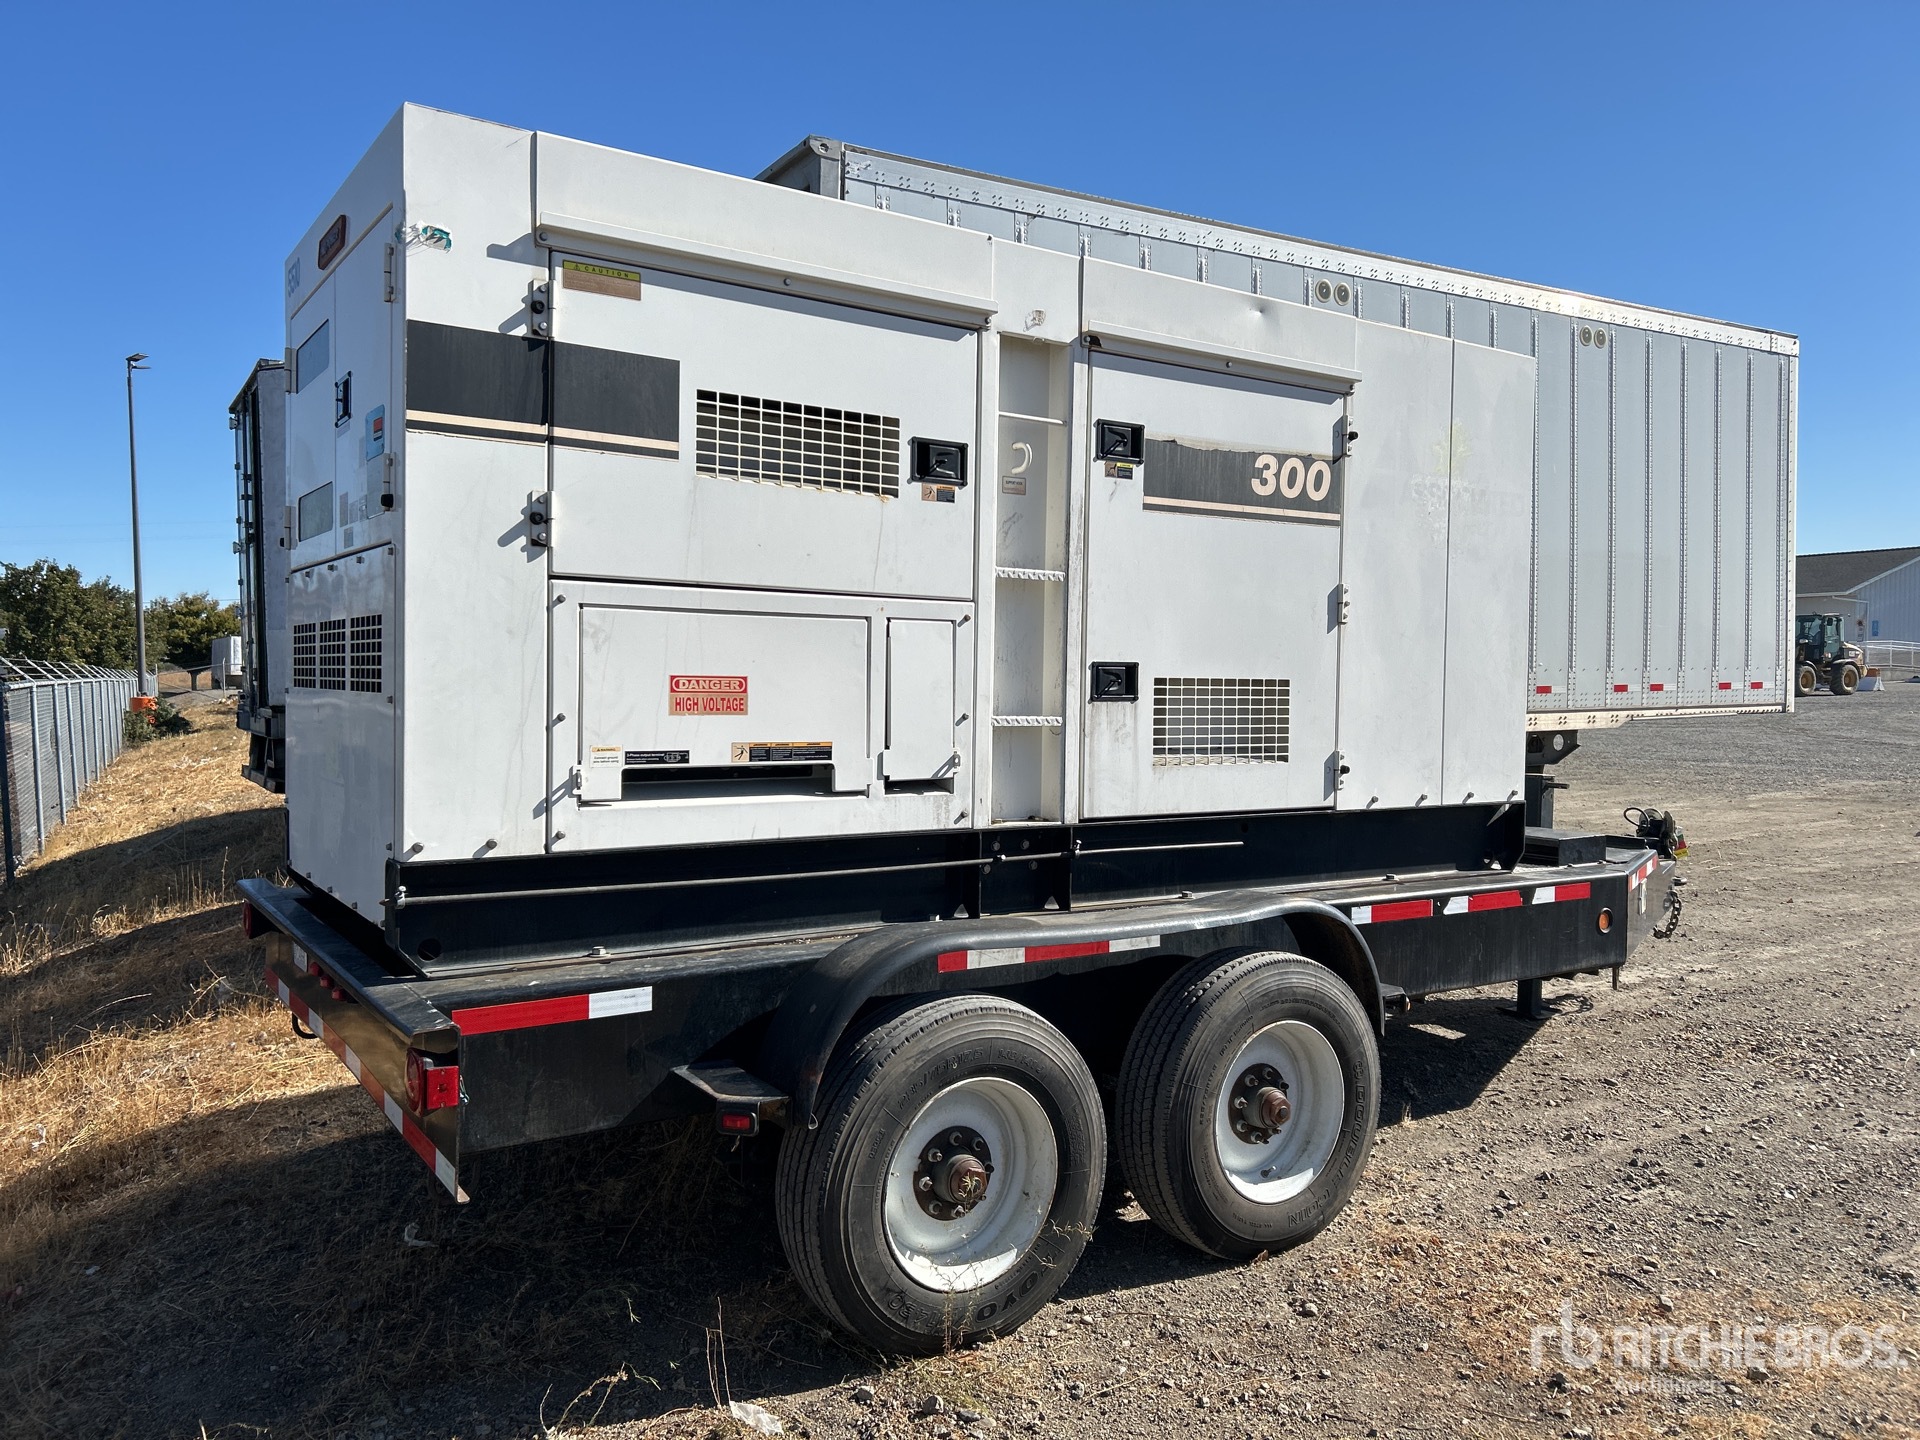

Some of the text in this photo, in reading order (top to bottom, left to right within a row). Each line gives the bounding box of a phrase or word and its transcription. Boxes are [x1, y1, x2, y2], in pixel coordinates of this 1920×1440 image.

[584, 265, 629, 278] CAUTION
[1250, 453, 1332, 501] 300
[678, 679, 741, 690] DANGER
[674, 696, 745, 712] HIGH VOLTAGE
